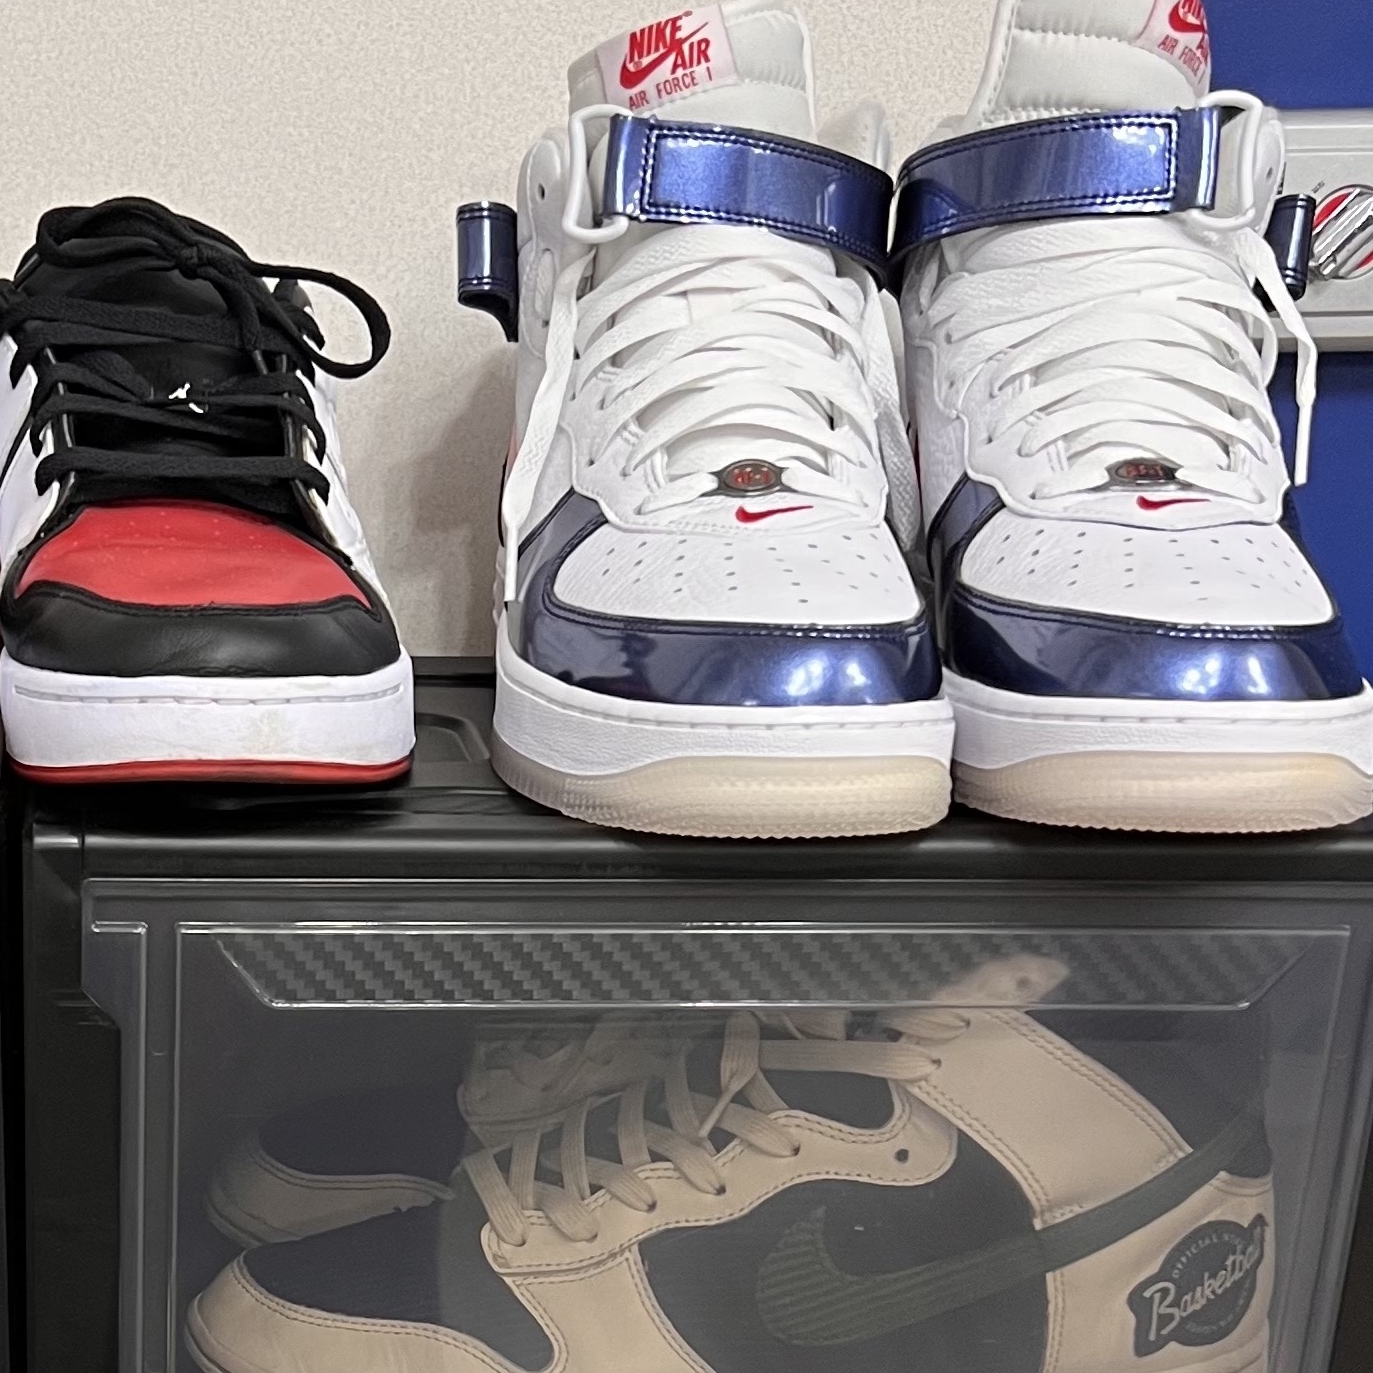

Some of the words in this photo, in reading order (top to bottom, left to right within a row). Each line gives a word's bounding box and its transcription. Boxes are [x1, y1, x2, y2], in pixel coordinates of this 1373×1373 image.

[628, 14, 683, 64] NIKE
[670, 38, 711, 76] AIR
[629, 90, 650, 111] AIR
[655, 70, 699, 99] FORCE
